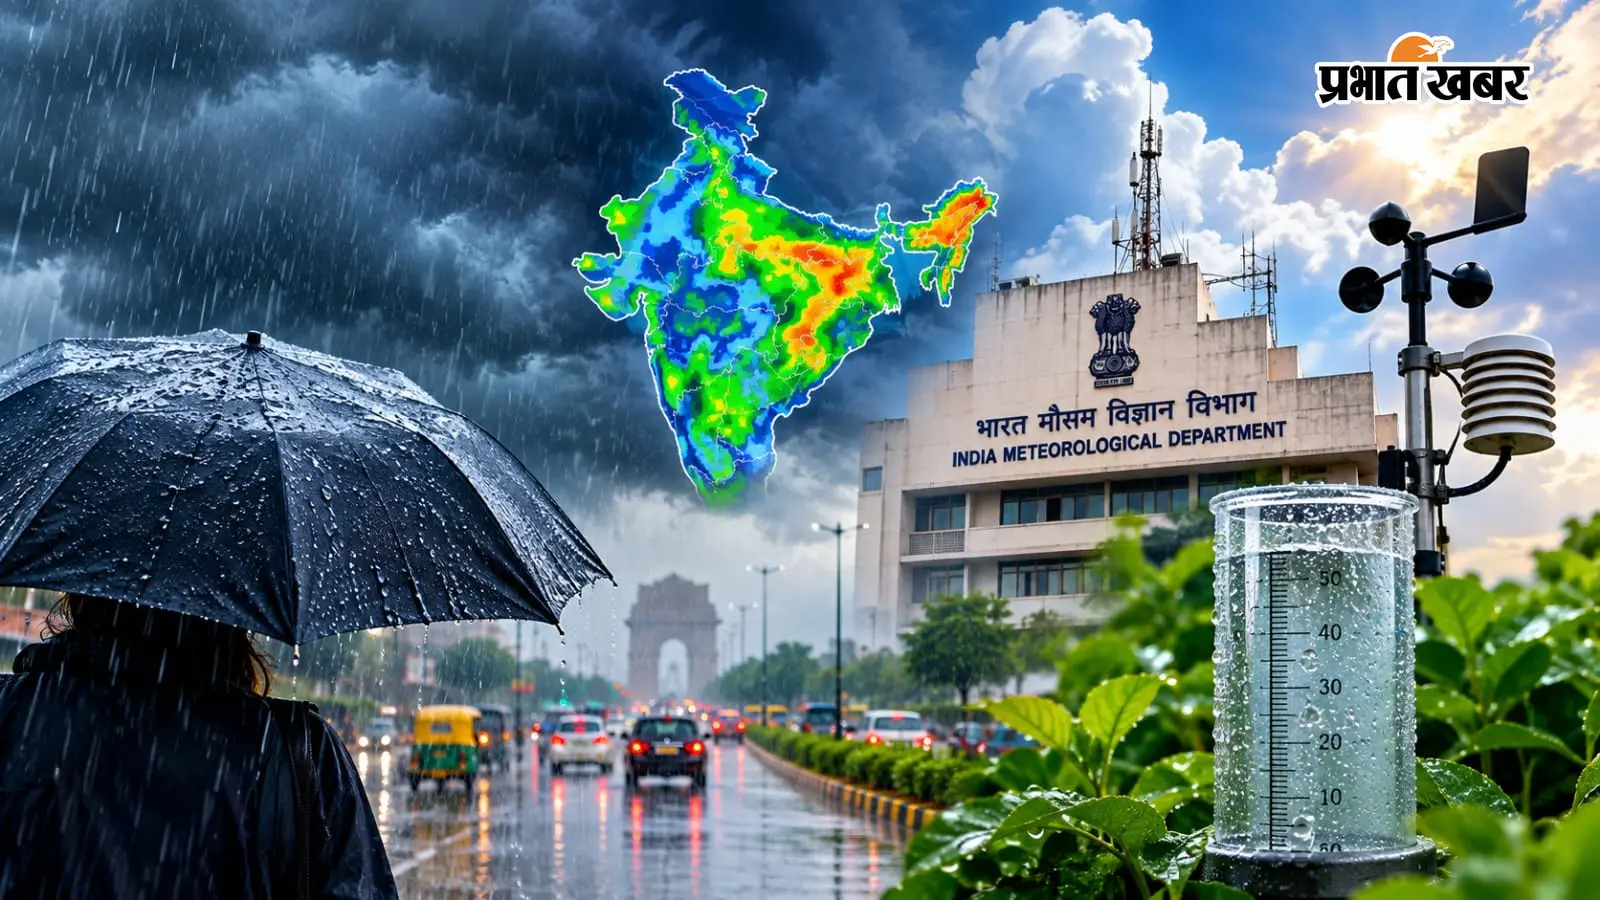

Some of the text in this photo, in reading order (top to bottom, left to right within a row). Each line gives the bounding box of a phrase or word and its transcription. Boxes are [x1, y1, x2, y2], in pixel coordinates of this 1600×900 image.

[976, 389, 1257, 438] भारत मौसम विज्ञान विभाग
[952, 420, 1287, 468] INDIA METEOROLOGICAL DEPARTMENT
[1319, 571, 1342, 587] 50
[1318, 624, 1342, 641] 40
[1319, 678, 1342, 695] 30
[1319, 733, 1342, 750] 20
[1320, 788, 1342, 806] 10
